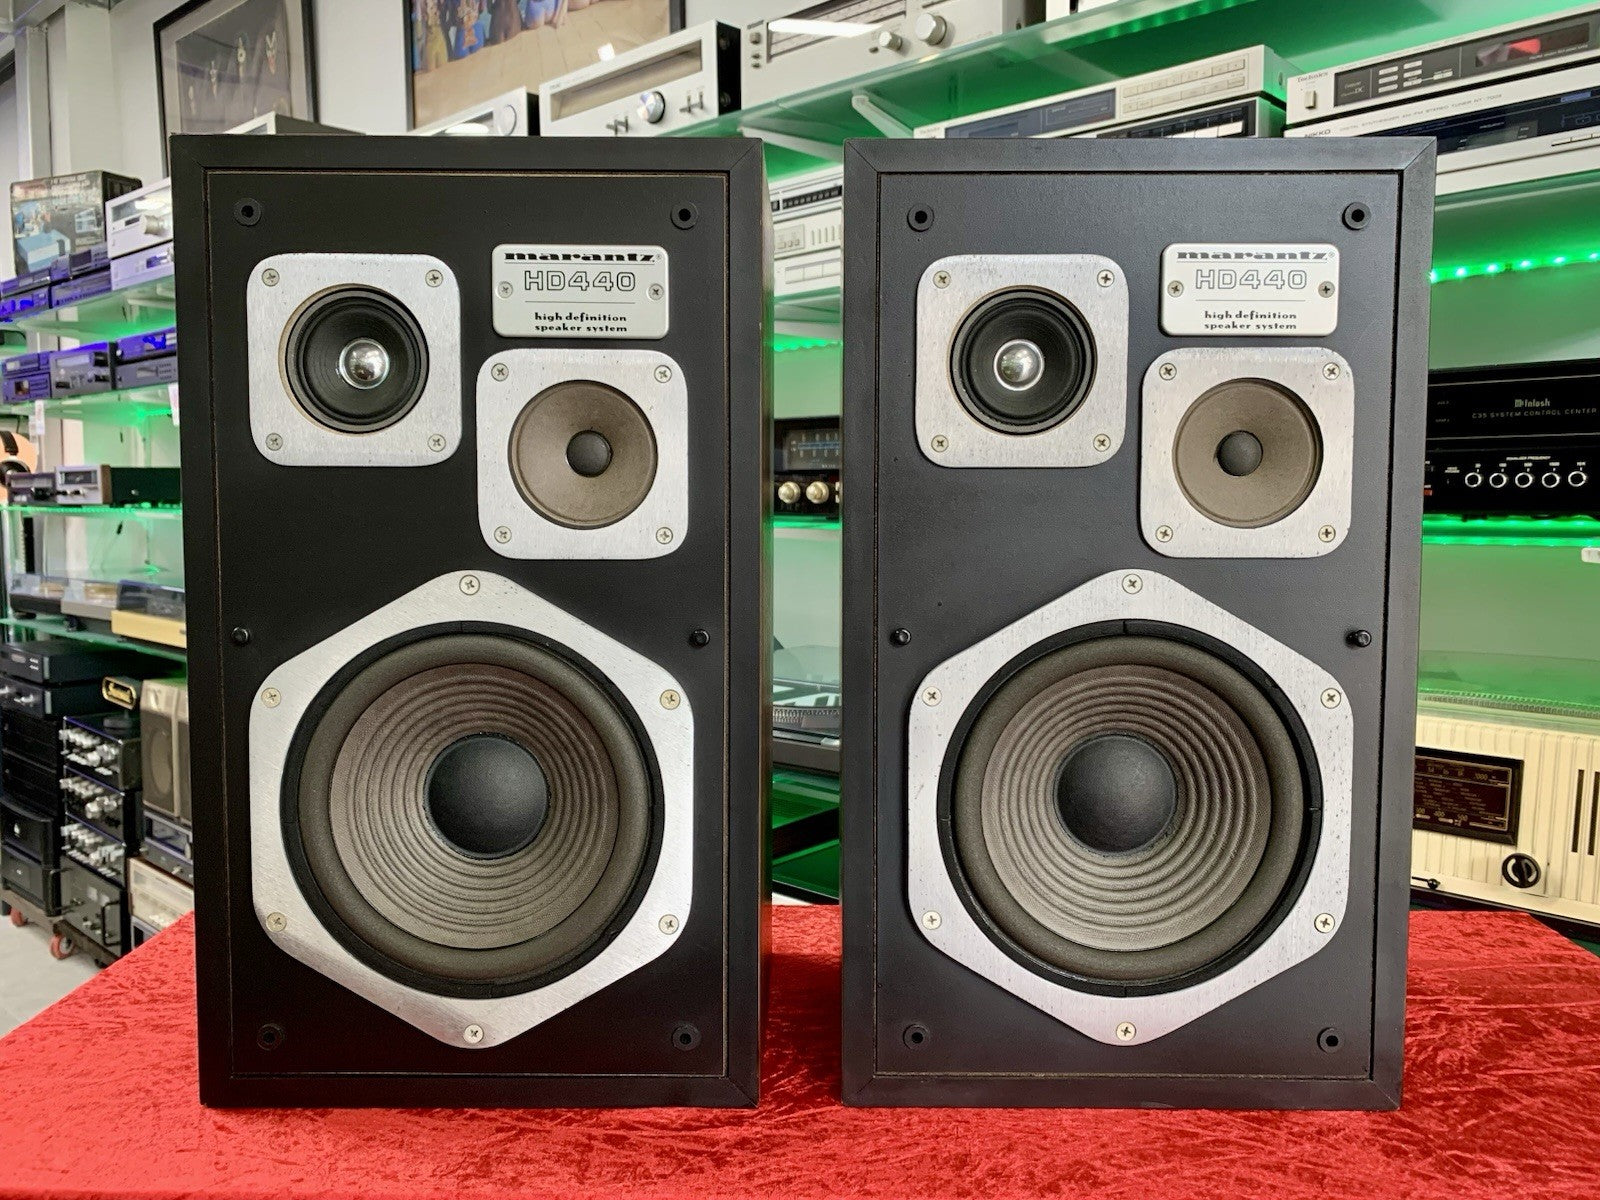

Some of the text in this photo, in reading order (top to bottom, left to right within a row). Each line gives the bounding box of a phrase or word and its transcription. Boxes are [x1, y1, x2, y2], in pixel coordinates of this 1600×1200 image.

[524, 270, 636, 292] HD440
[1195, 269, 1307, 290] HD440
[534, 312, 627, 322] high definition
[1204, 310, 1297, 320] high definition
[534, 323, 628, 334] speaker system
[1204, 321, 1297, 331] speaker system
[1564, 407, 1597, 415] CENTER
